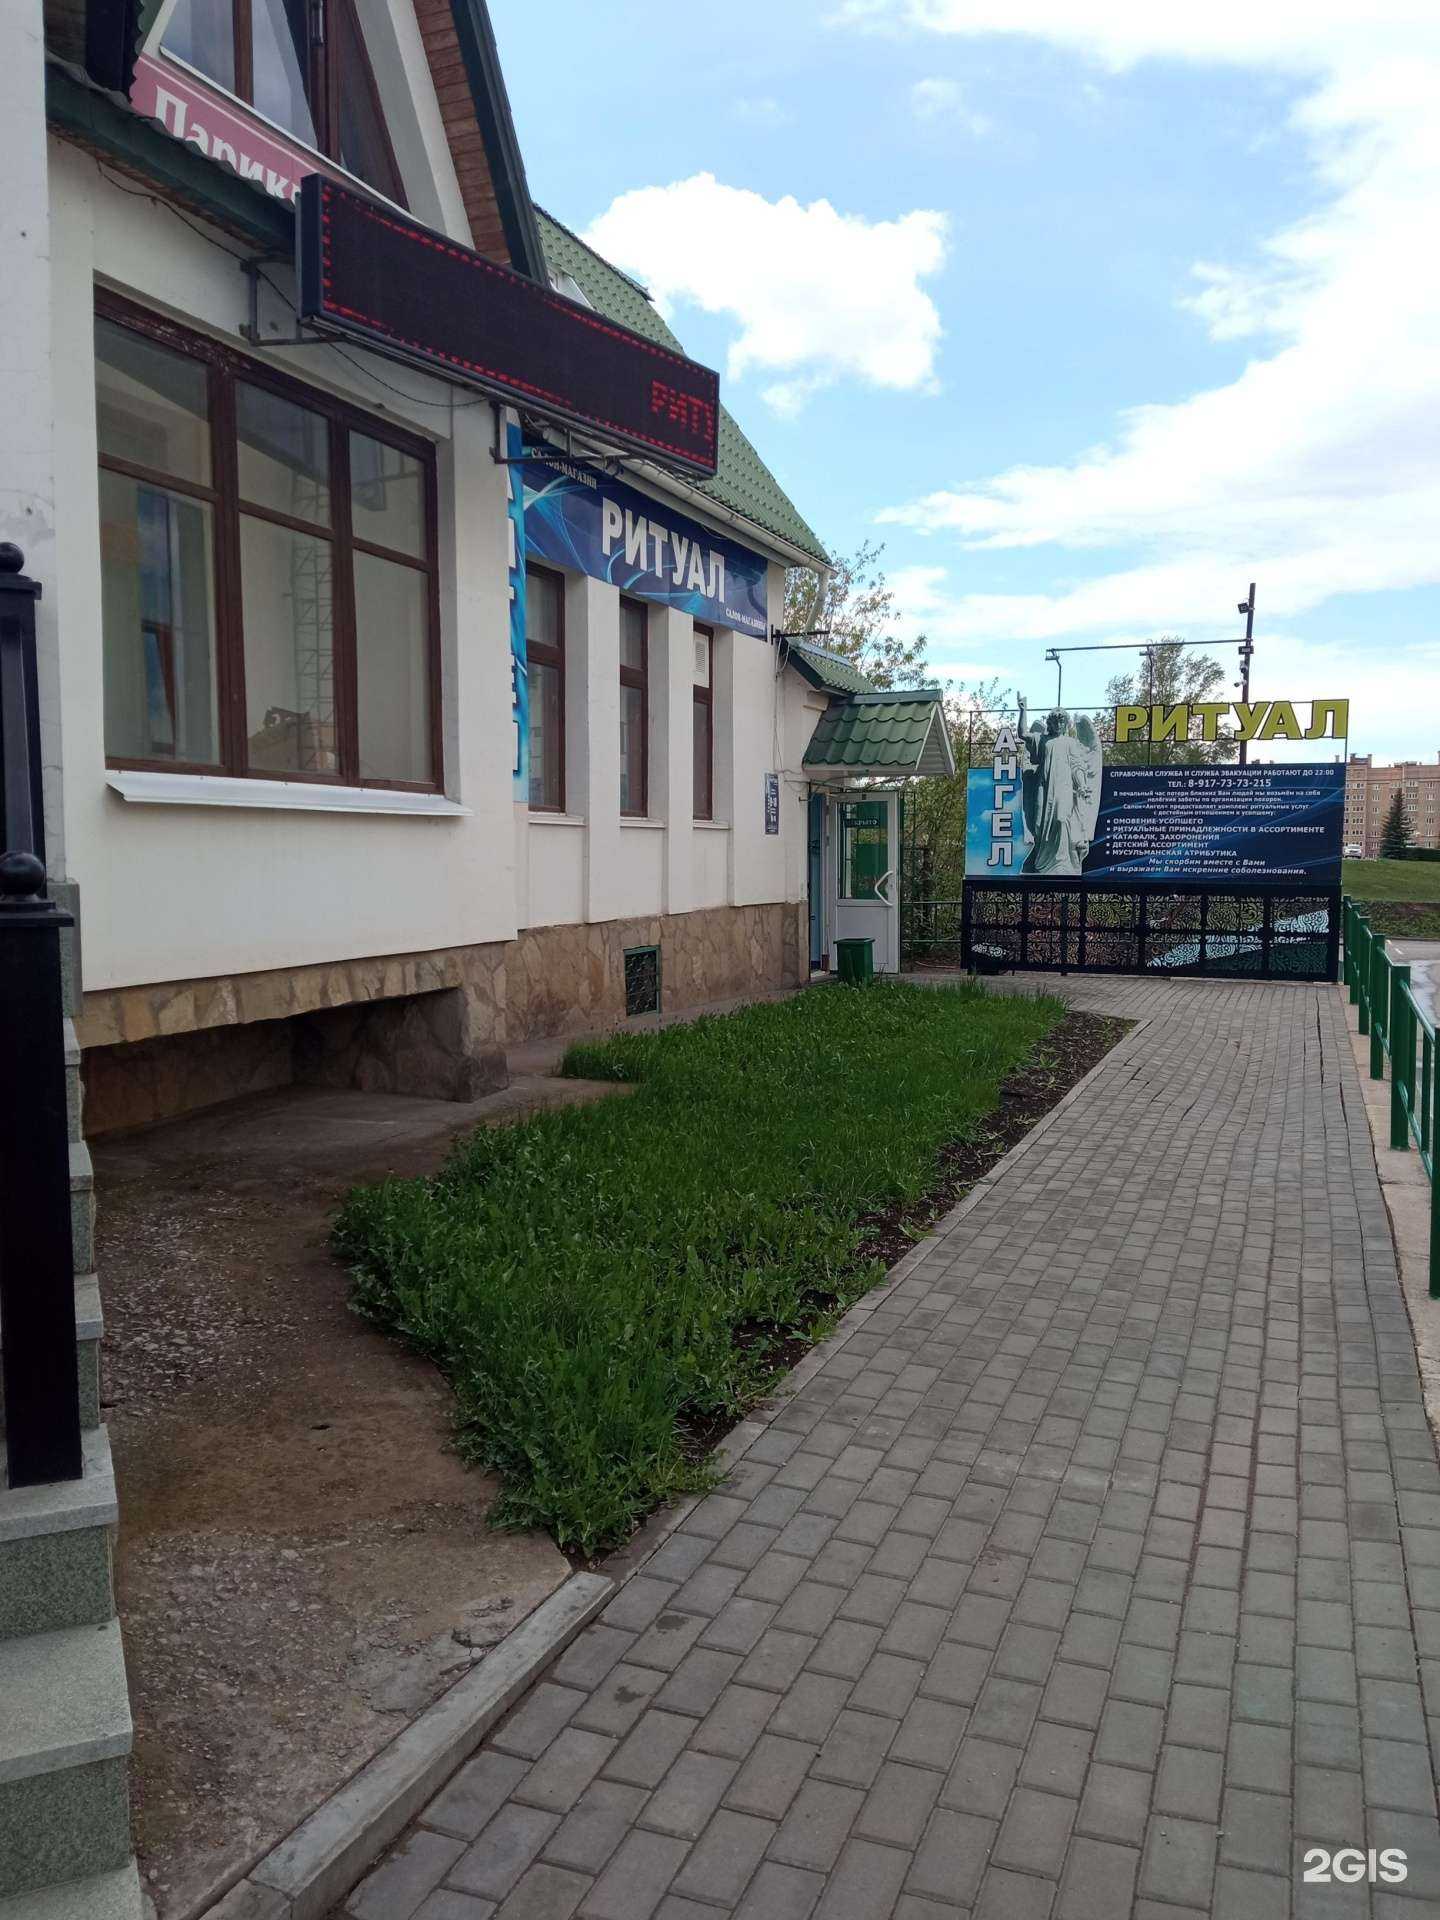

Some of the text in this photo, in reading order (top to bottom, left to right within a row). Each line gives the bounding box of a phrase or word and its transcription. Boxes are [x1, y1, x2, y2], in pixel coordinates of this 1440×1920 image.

[601, 496, 725, 604] РИТУАЛ
[1115, 699, 1349, 742] РИТУАЛ
[1167, 778, 1271, 788] ТЕЛ.: 8-917-73-73-215
[1302, 769, 1313, 777] ДО
[986, 727, 1019, 867] АНГЕЛ
[1112, 841, 1149, 849] ДЕТСКИЙ
